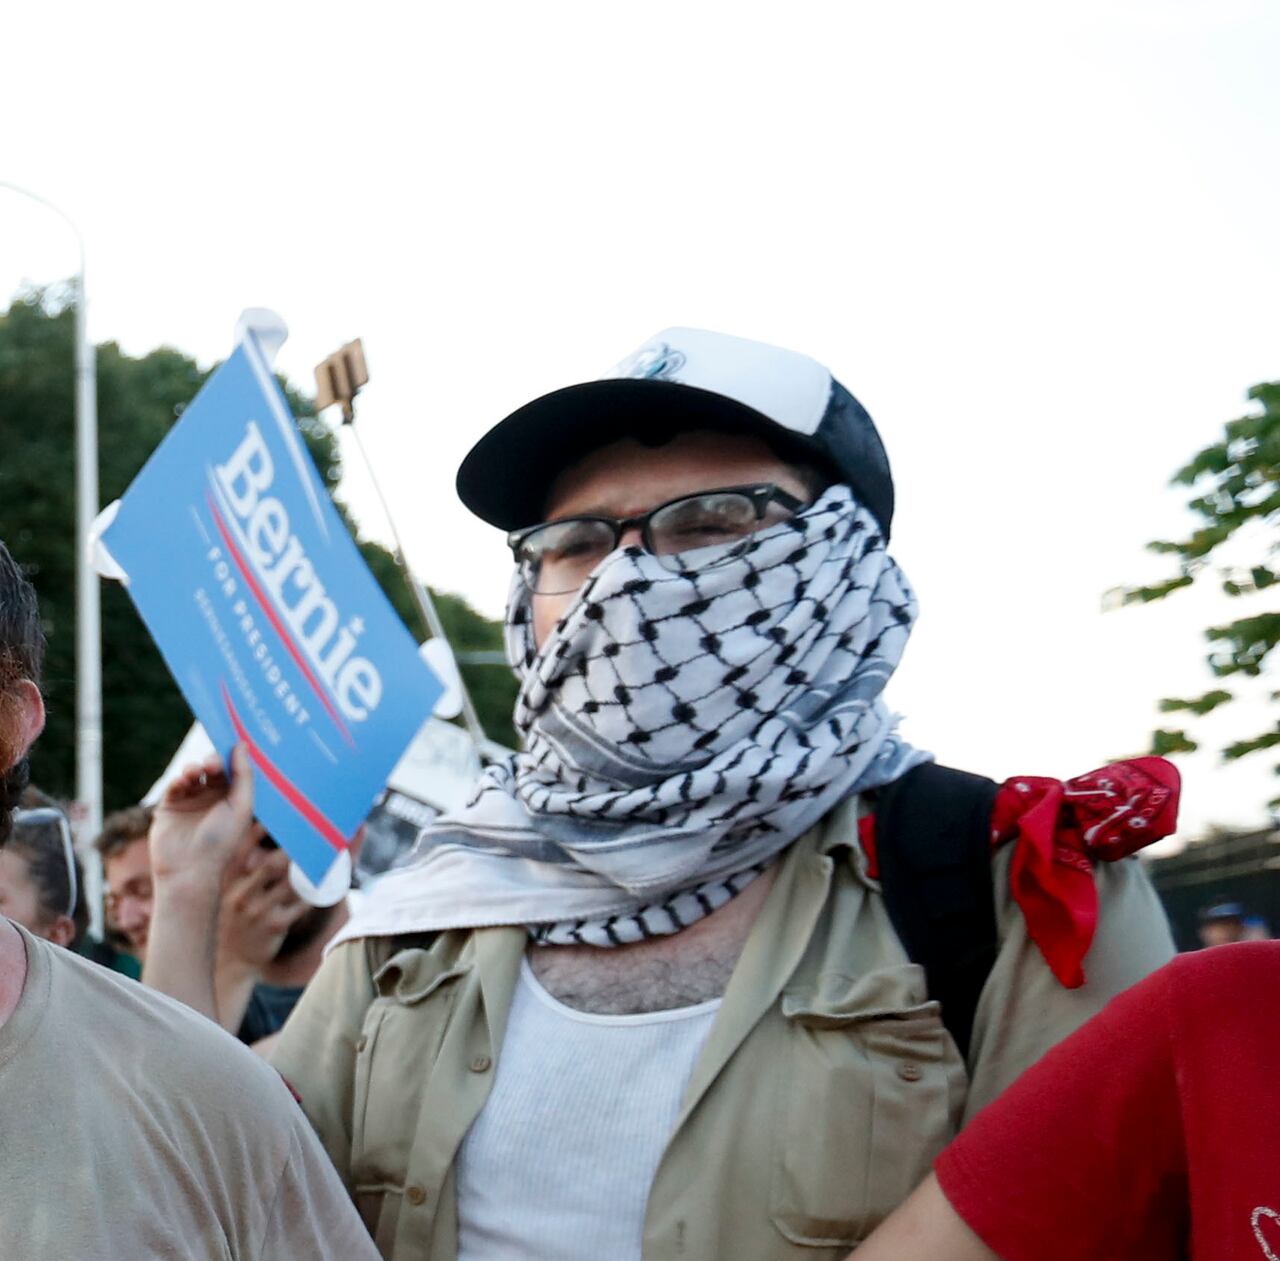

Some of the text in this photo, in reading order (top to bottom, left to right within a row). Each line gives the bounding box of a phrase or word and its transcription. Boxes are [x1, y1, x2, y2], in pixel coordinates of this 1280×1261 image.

[207, 547, 310, 725] FOR PRESIDENT
[213, 420, 382, 722] Bernie
